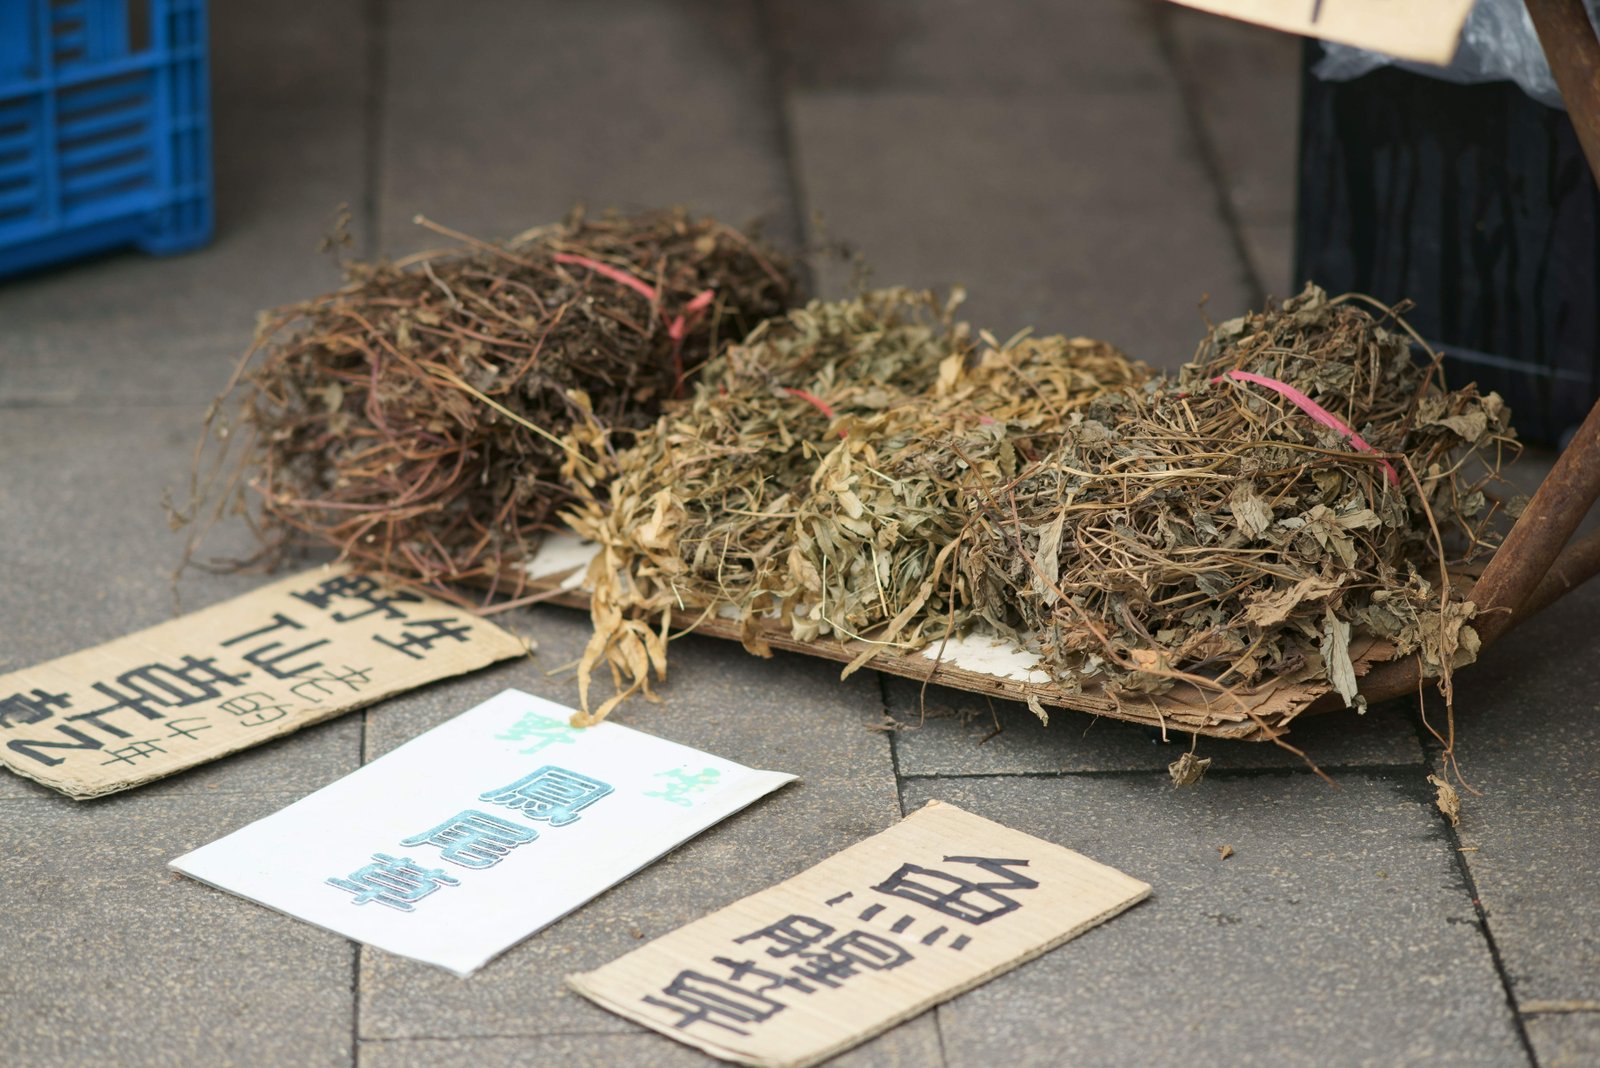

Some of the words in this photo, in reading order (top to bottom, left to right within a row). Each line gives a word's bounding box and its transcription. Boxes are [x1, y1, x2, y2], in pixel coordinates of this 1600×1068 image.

[291, 573, 475, 660] 野生
[100, 665, 374, 767] 老的4年
[494, 711, 721, 808] 野生
[323, 764, 616, 913] 鳳尾草
[641, 854, 1040, 1036] 魚腥草
